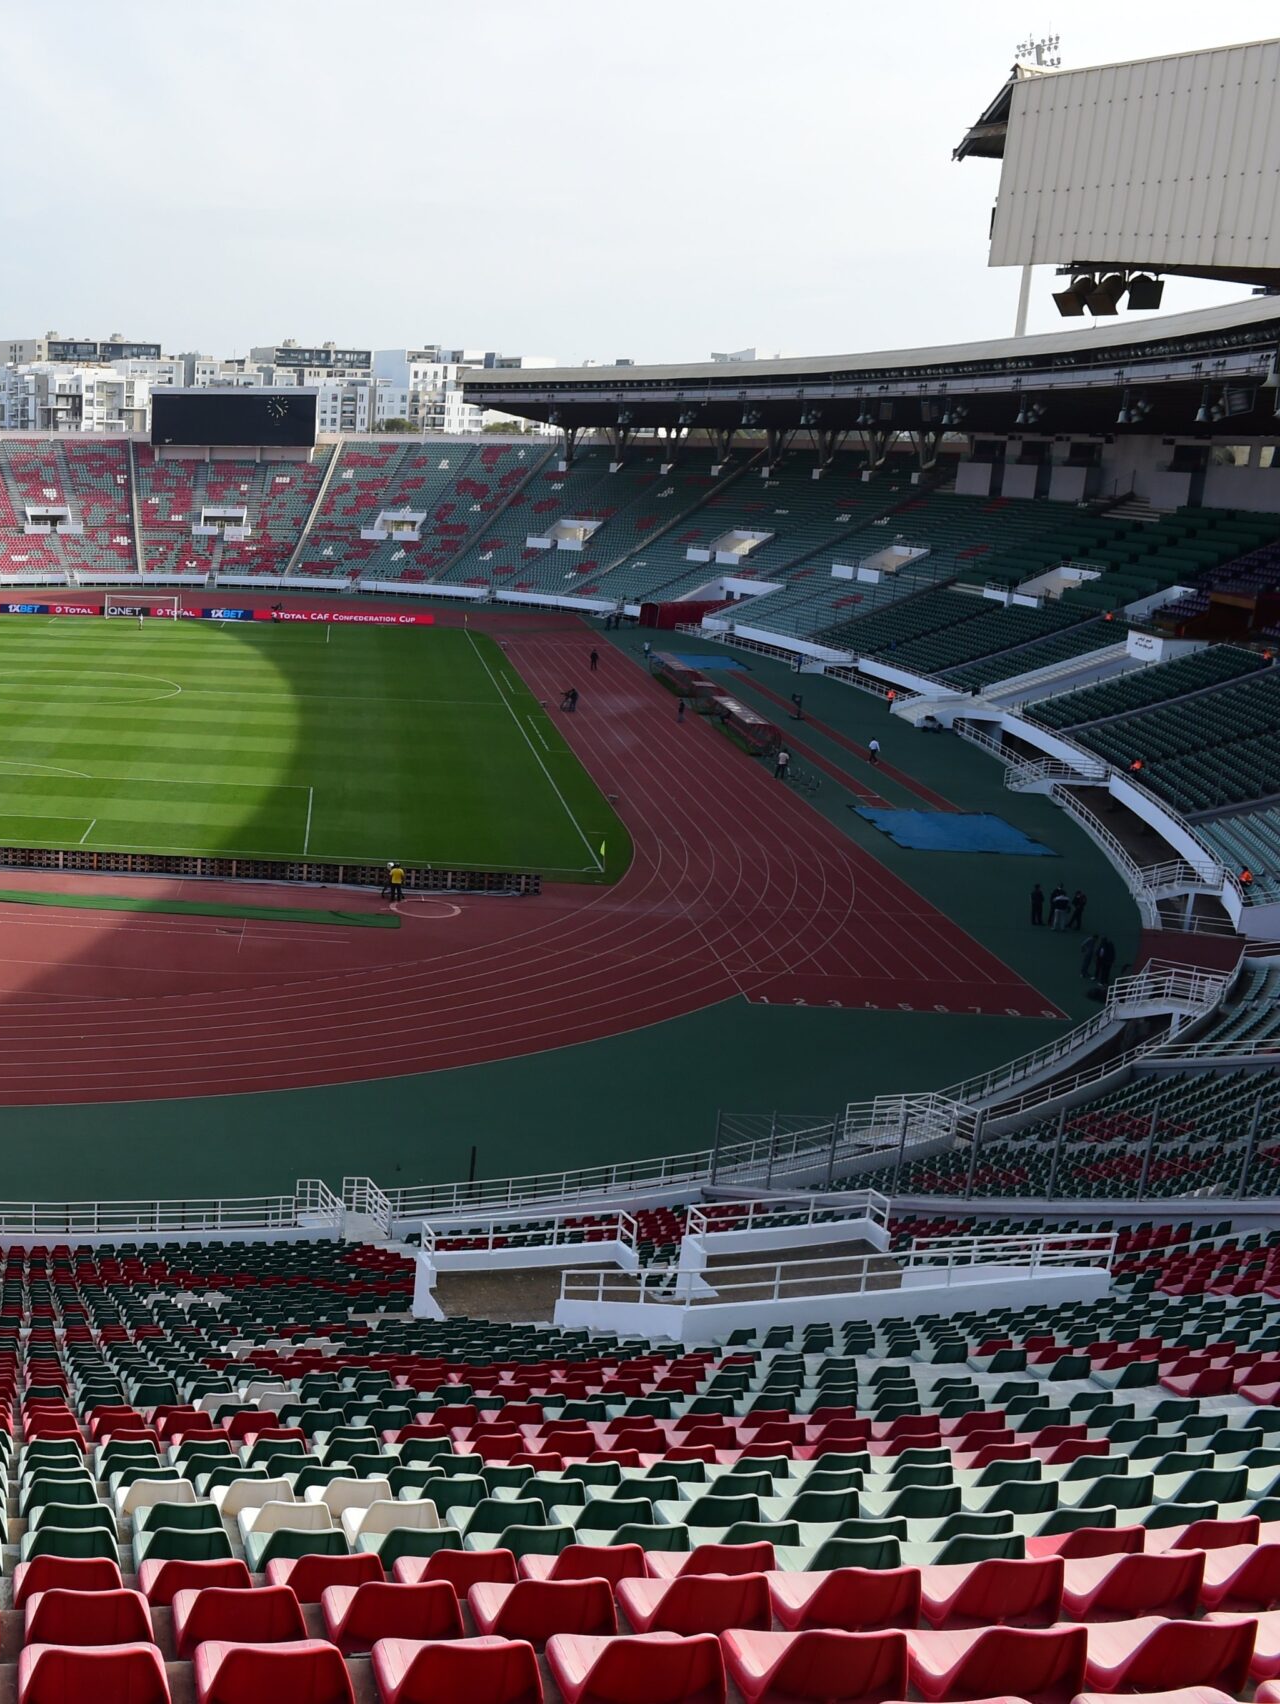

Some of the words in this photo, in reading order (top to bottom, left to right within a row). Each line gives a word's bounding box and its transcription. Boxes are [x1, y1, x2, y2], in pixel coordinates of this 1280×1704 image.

[8, 604, 40, 613] 1XBET
[63, 606, 93, 614] TOTAL
[108, 607, 142, 615] QNET
[211, 609, 244, 618] 1XBET
[278, 612, 307, 620] TOTAL
[332, 613, 396, 622] CONFEDERATION
[399, 615, 416, 623] CUP
[792, 998, 808, 1006] 2
